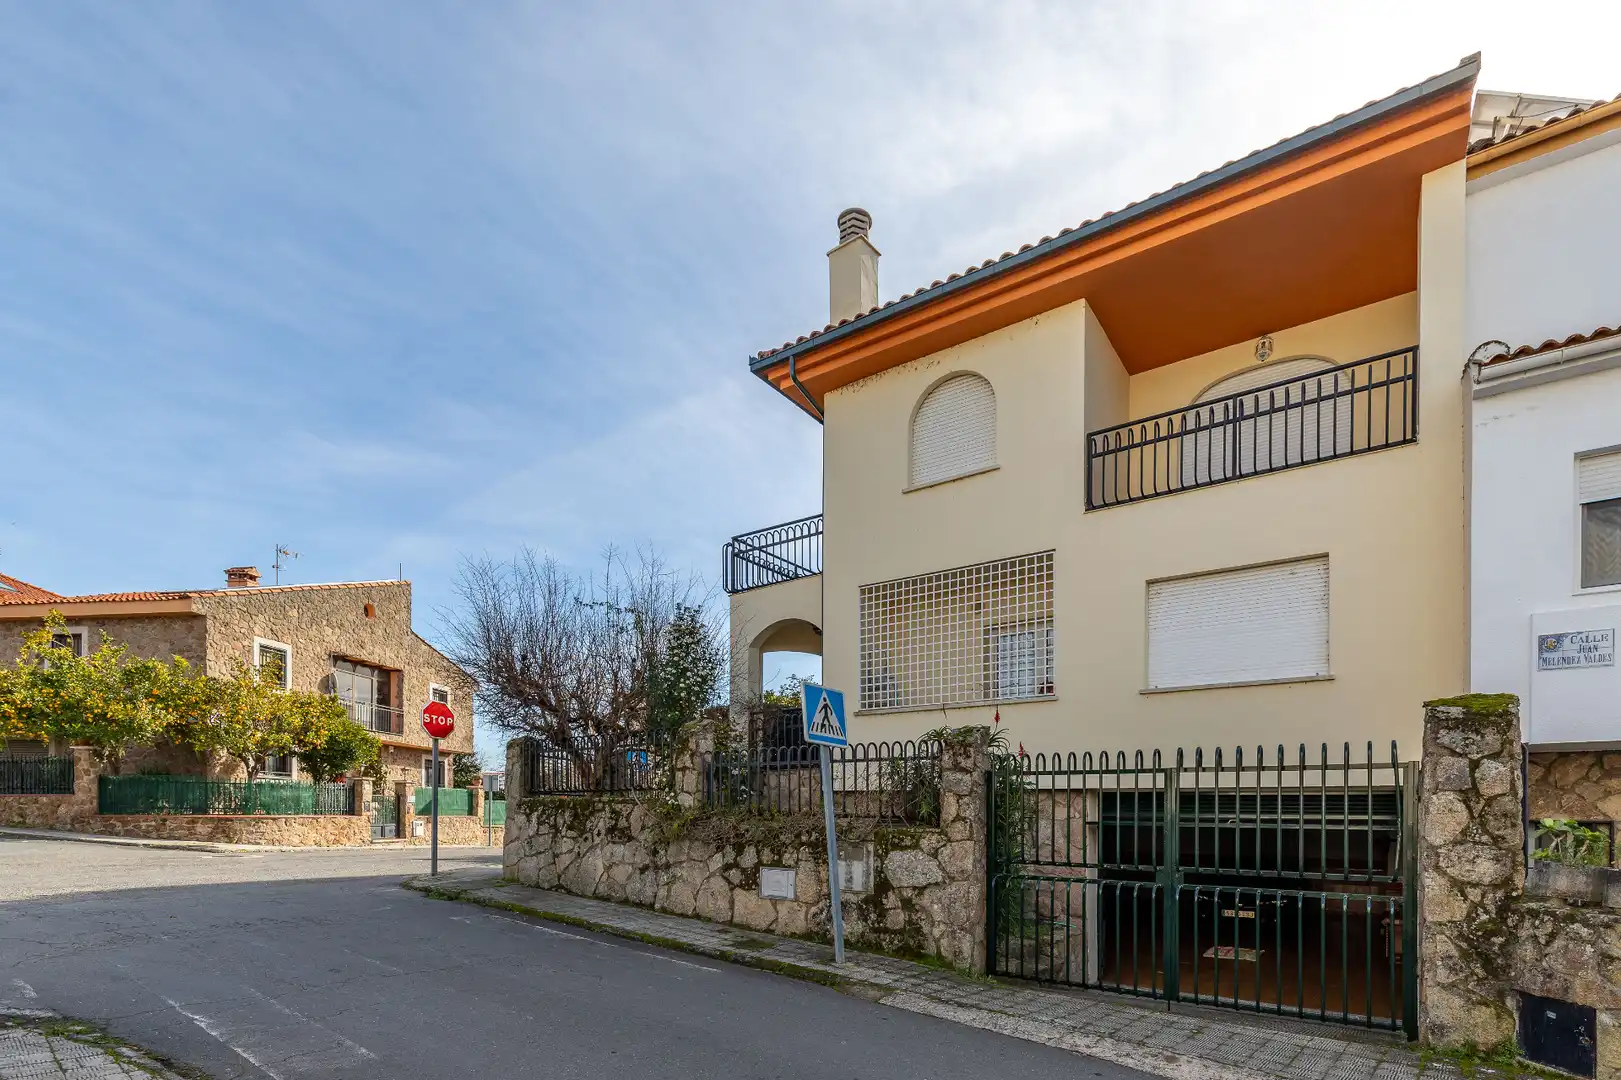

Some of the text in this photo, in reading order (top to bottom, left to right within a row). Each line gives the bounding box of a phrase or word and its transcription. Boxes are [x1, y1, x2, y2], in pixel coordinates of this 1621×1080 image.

[1570, 634, 1609, 644] CALLE
[1577, 644, 1598, 654] JUAN
[423, 713, 453, 726] STOP
